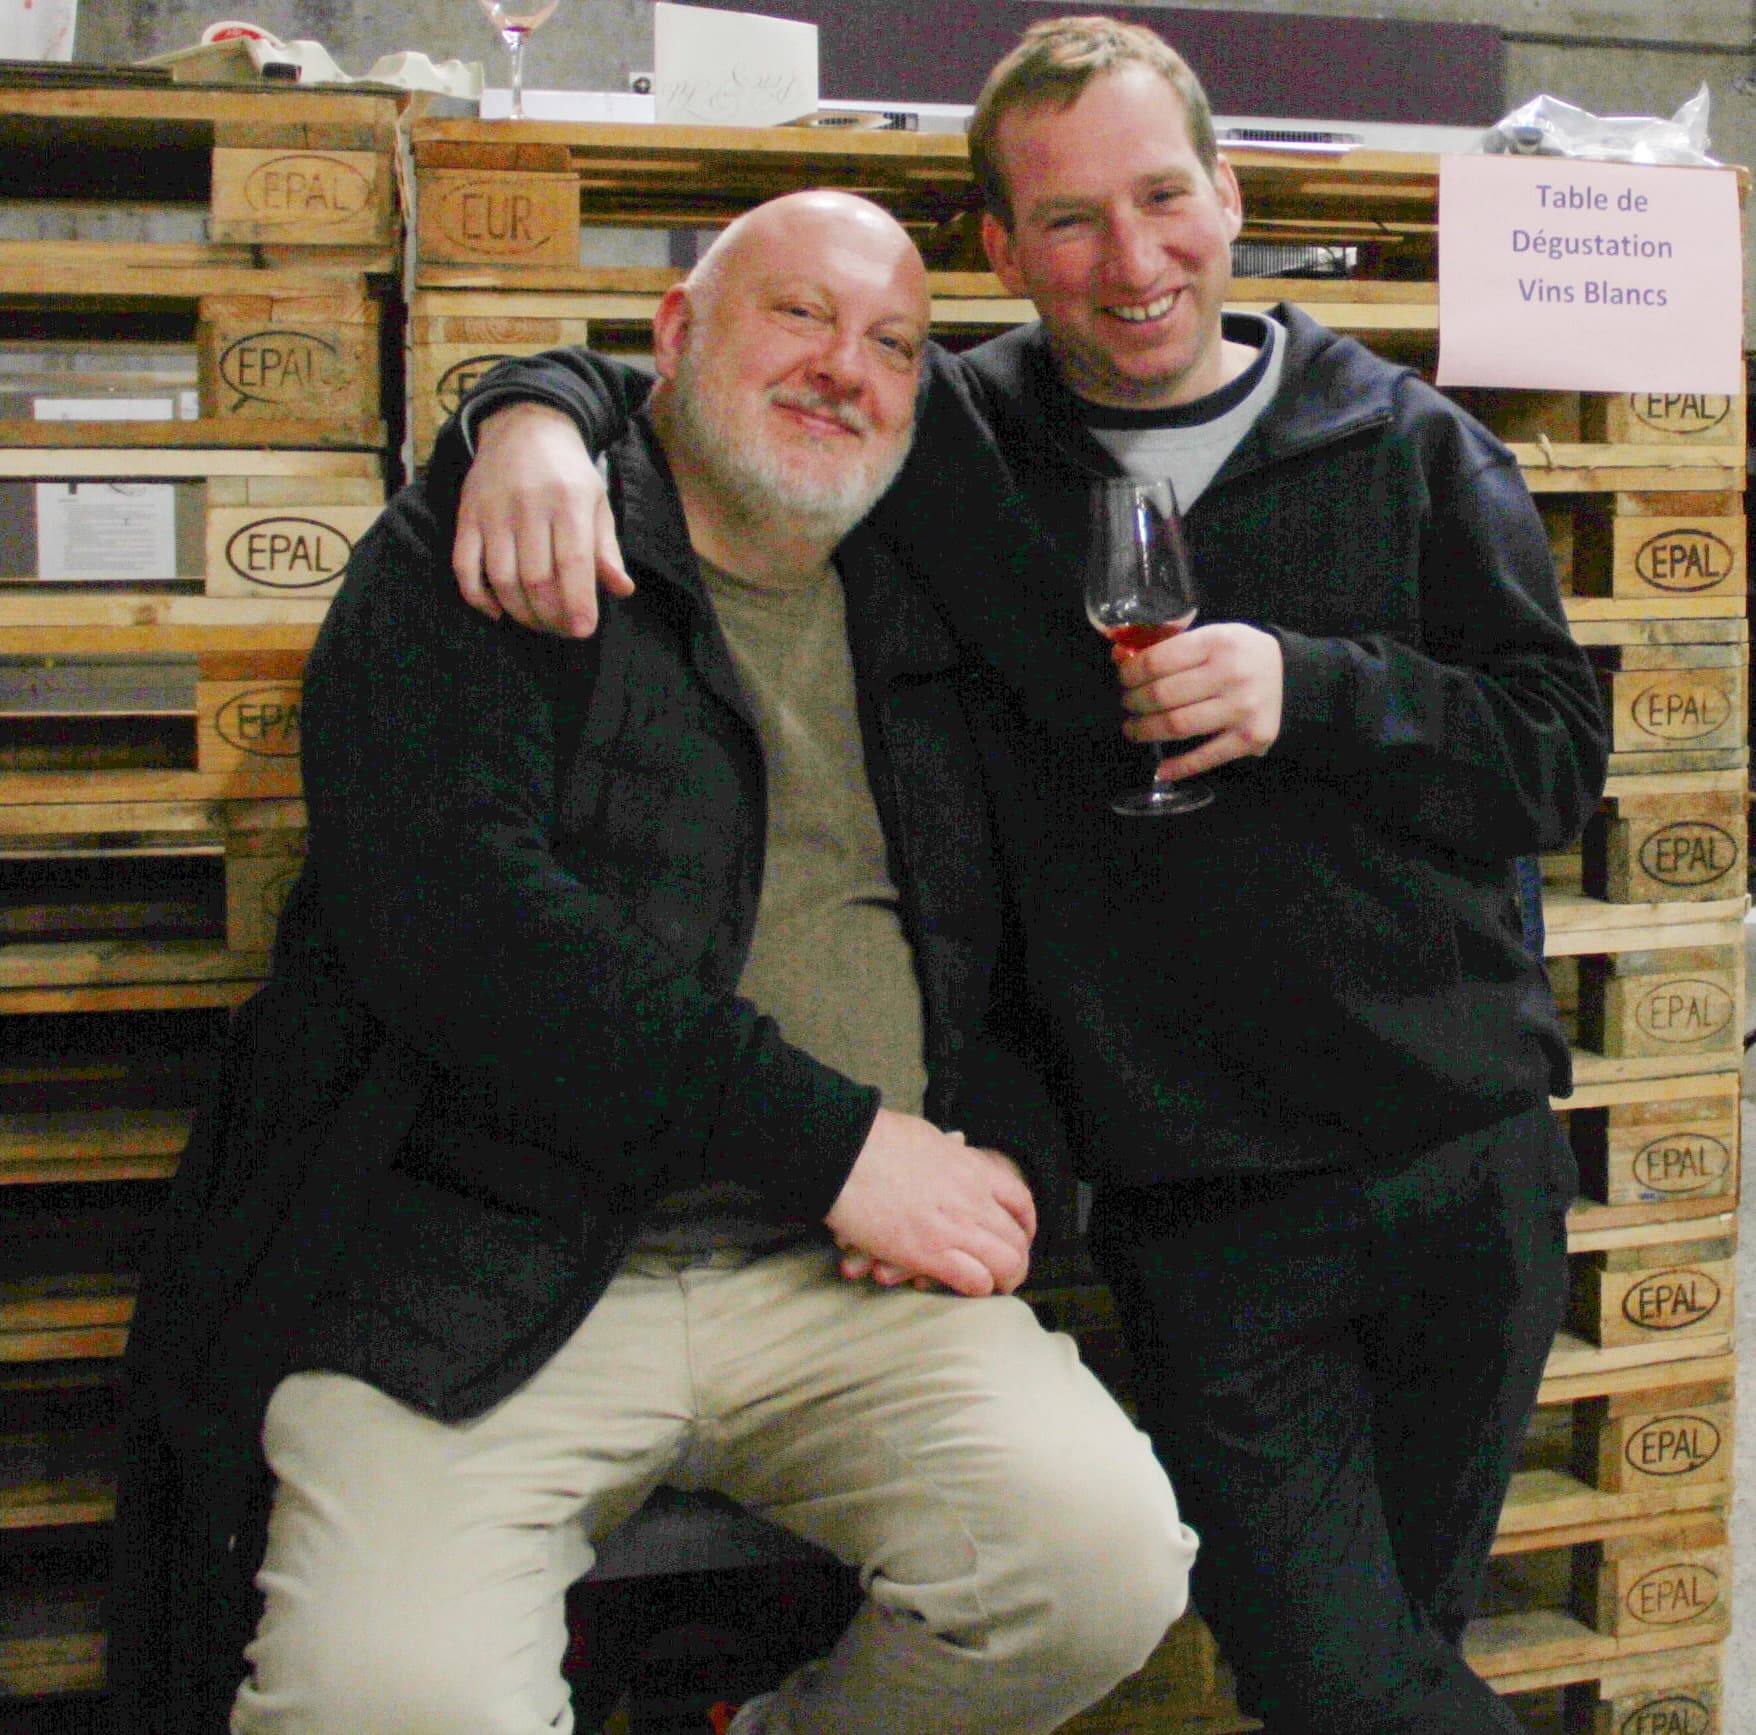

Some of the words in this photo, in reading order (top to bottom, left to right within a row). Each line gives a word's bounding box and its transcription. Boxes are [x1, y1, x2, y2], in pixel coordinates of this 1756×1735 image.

[264, 171, 350, 211] EPAL
[1536, 184, 1608, 211] Table
[1616, 188, 1649, 213] de
[461, 192, 534, 242] EUR
[1512, 229, 1673, 260] Dégustation
[1518, 279, 1575, 303] Vins
[1584, 280, 1668, 307] Blancs
[1646, 392, 1716, 420] EPAL
[246, 534, 332, 573] EPAL
[1650, 544, 1720, 579] EPAL
[237, 703, 302, 740] EPA
[1648, 693, 1718, 726] EPAL
[1655, 834, 1727, 873] EPAL
[1650, 995, 1713, 1030] EPAL
[1646, 1146, 1709, 1182] EPAL
[1638, 1279, 1706, 1321] EPAL
[1641, 1428, 1704, 1465] EPAL
[1640, 1576, 1704, 1615] EPAL
